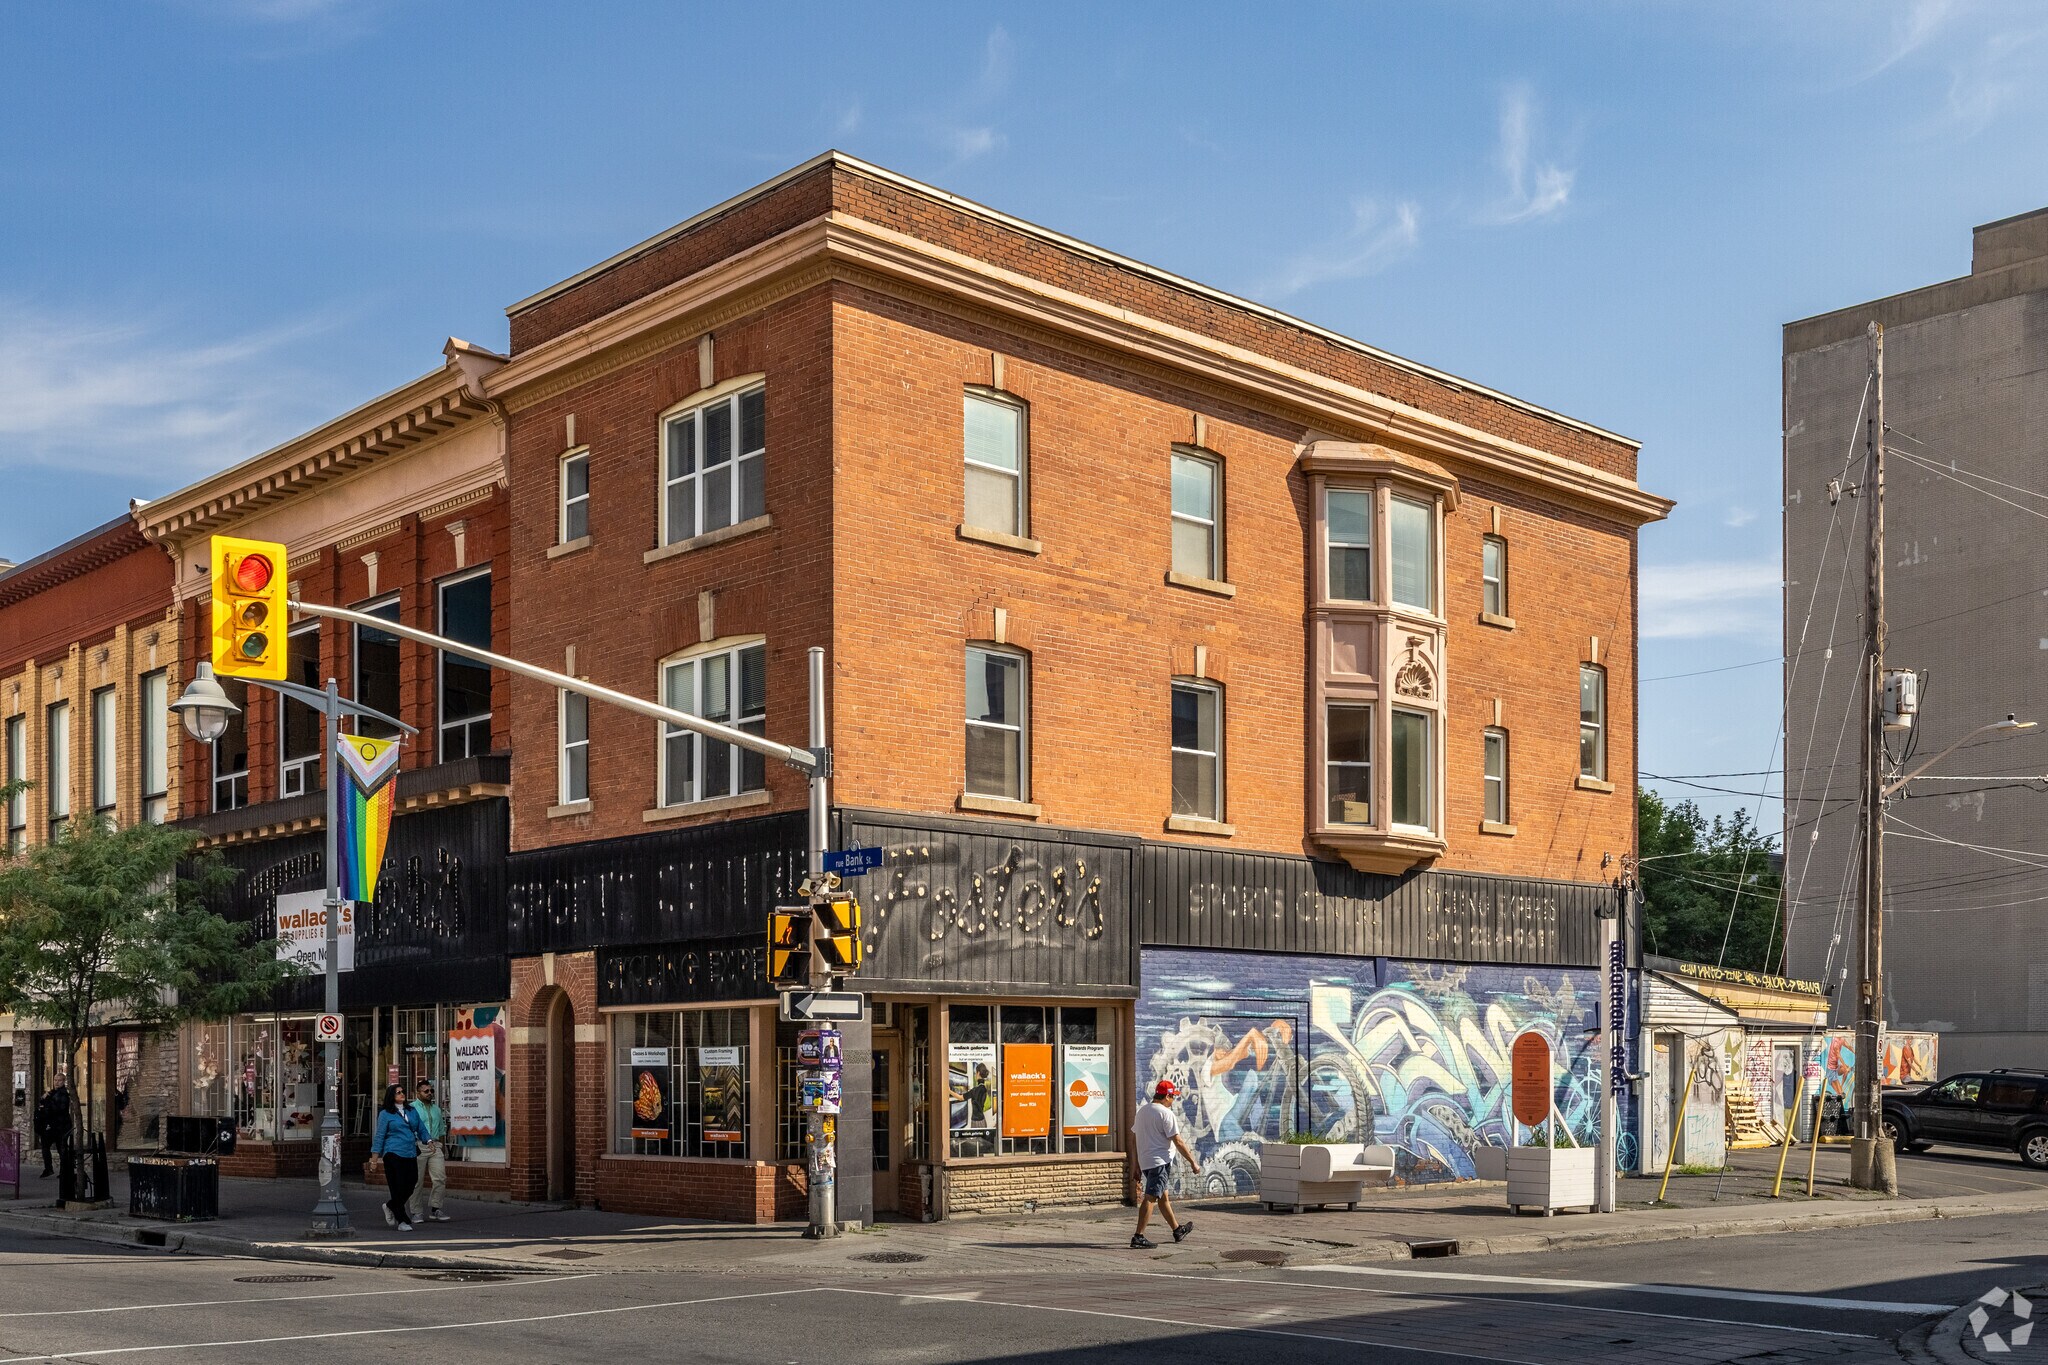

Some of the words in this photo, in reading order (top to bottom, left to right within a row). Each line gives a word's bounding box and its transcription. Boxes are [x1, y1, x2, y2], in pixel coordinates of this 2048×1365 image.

[836, 860, 844, 868] rue
[845, 852, 863, 867] Bank
[279, 905, 352, 929] wallac's
[296, 949, 317, 963] Open
[1610, 940, 1625, 1031] UNCOMMON
[456, 1045, 489, 1057] WALLACK'S
[457, 1061, 471, 1071] NOW
[472, 1060, 488, 1070] OPEN
[1610, 1046, 1626, 1096] SPACE
